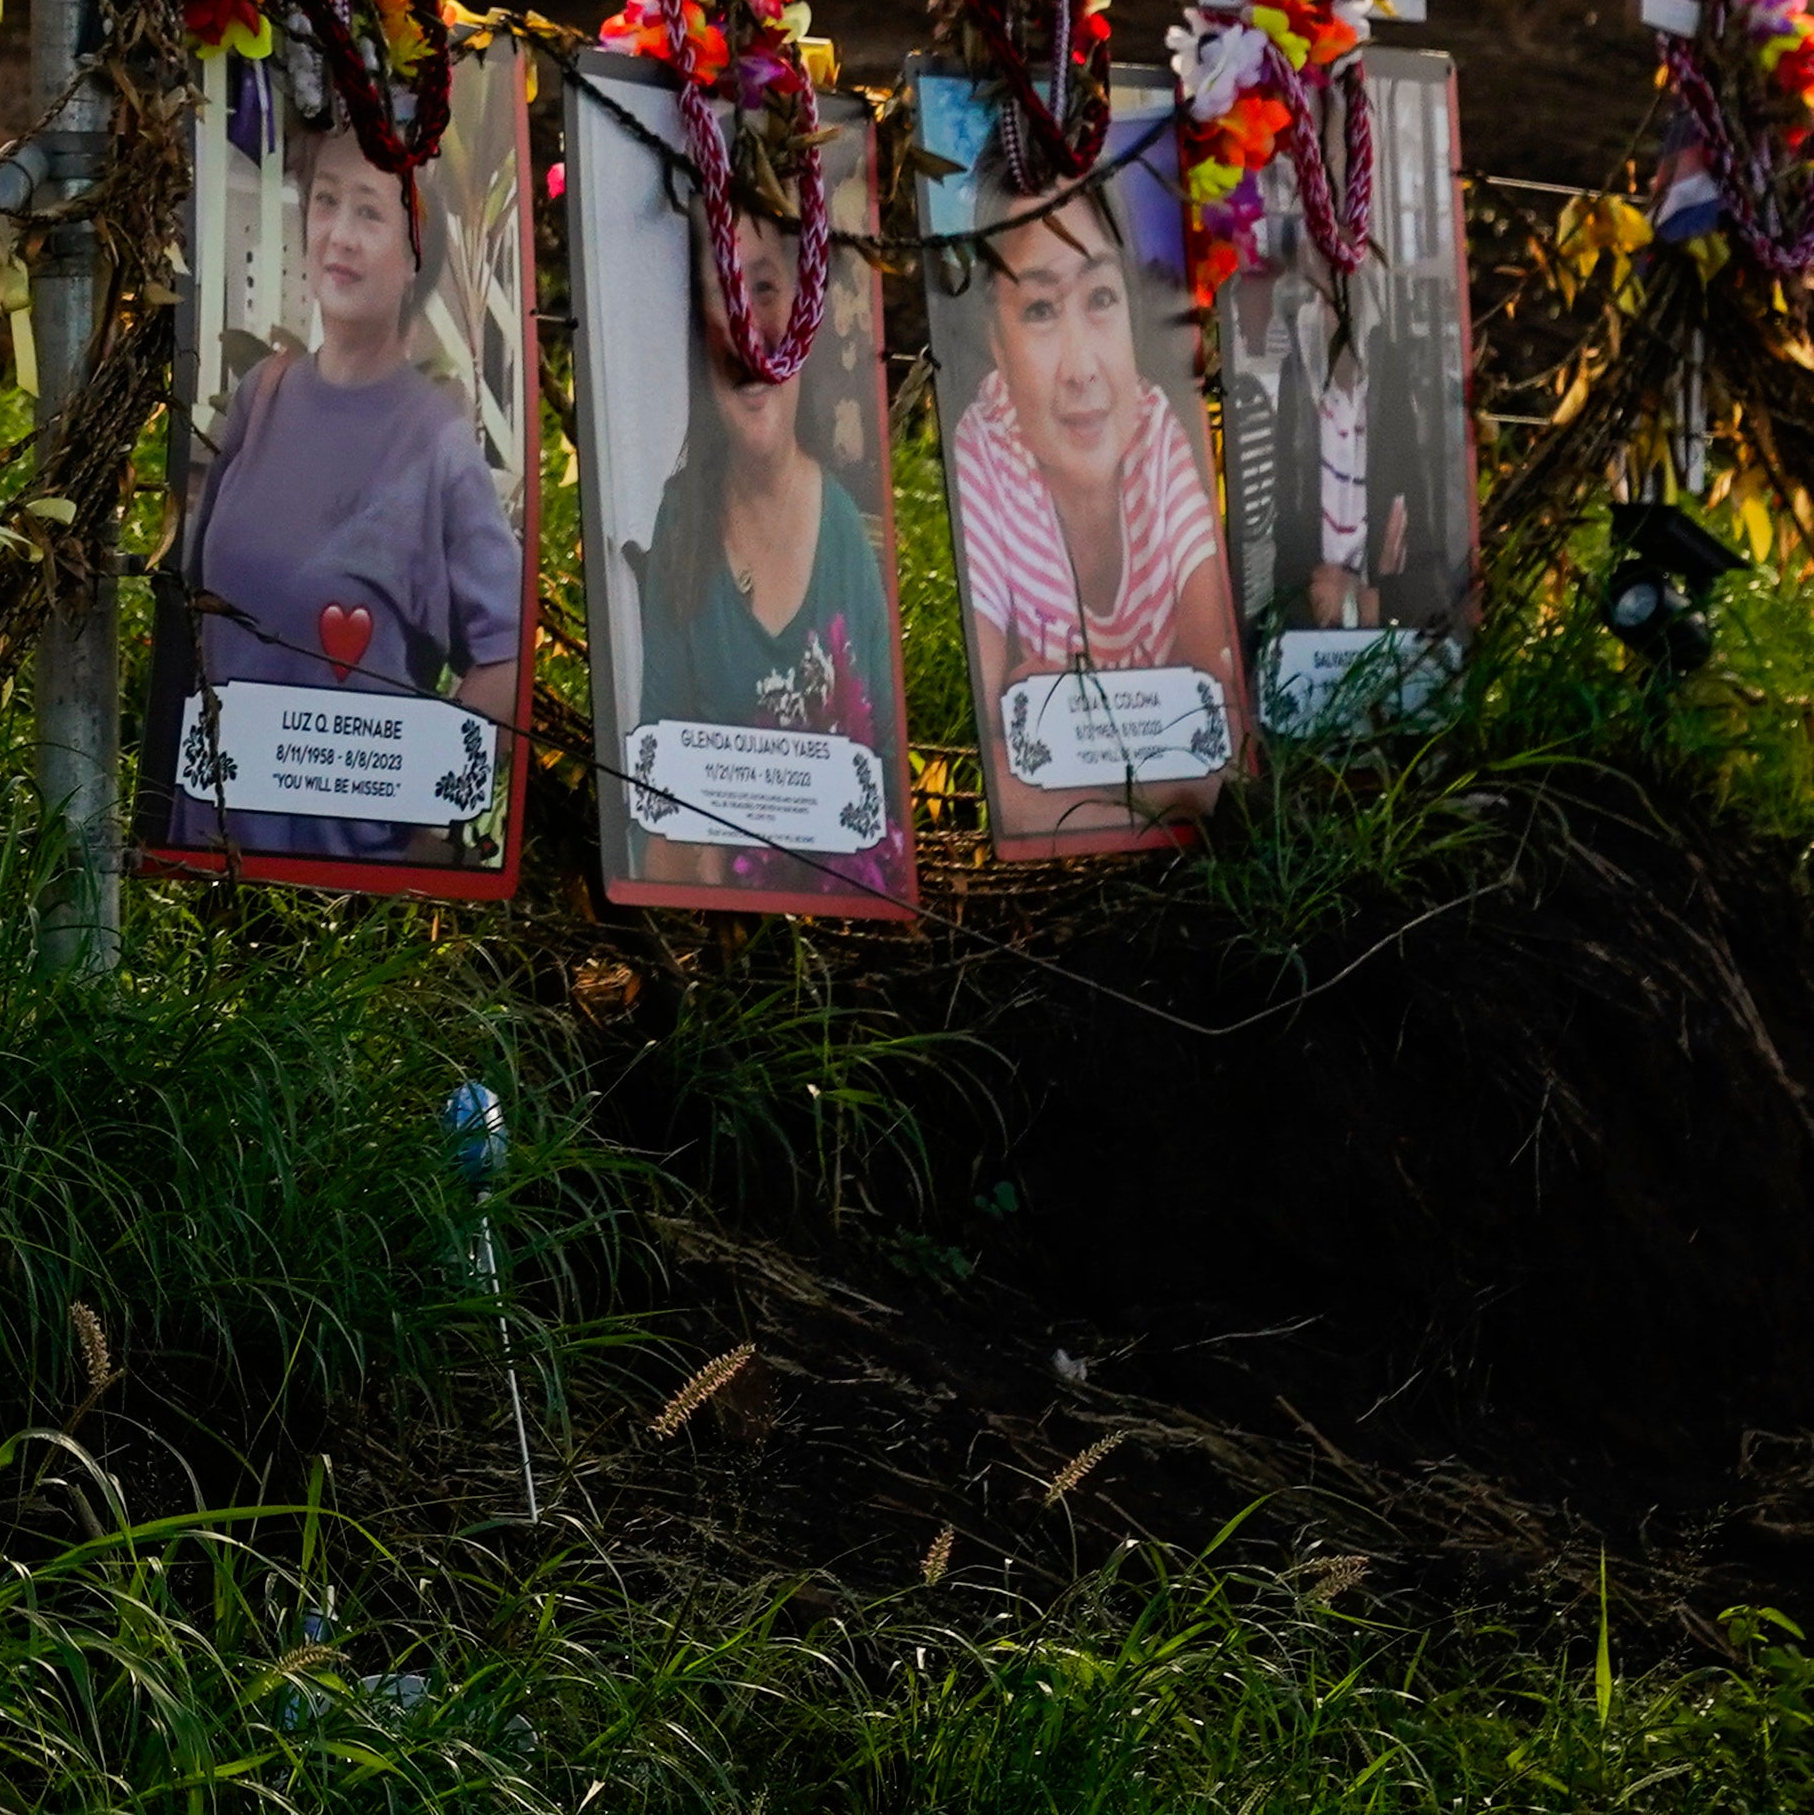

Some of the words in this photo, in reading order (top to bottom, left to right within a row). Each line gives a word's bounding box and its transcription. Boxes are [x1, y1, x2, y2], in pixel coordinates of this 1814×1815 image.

[282, 710, 314, 732] LUZ
[332, 715, 404, 740] BERNABE
[680, 728, 732, 752] GLENDA
[733, 733, 791, 757] QUIJANO
[275, 743, 335, 766] 8/11/1958
[344, 749, 404, 771] 8/8/2023
[304, 774, 332, 793] WILL
[333, 777, 350, 794] BE
